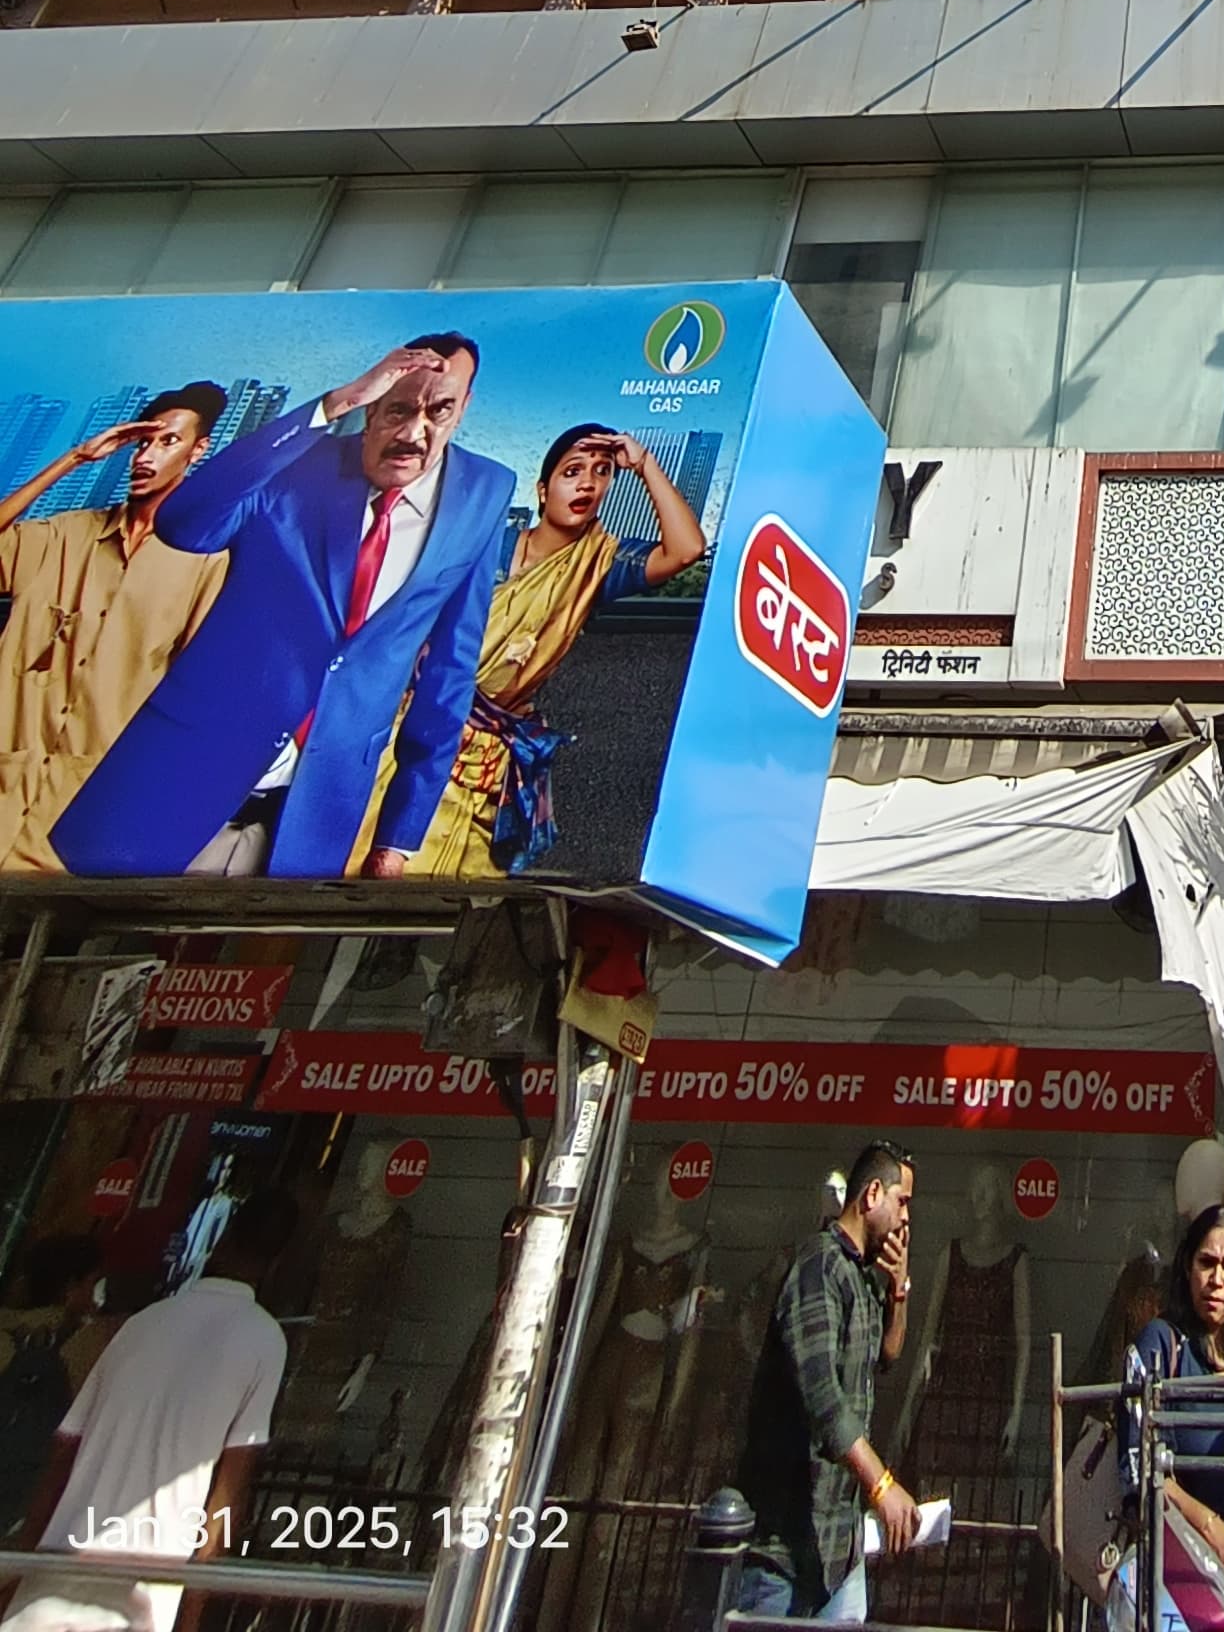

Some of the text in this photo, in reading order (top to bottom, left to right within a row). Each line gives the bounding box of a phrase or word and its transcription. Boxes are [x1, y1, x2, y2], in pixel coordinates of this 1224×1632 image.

[620, 379, 721, 396] MAHANAGAR
[648, 397, 683, 413] GAS
[755, 544, 840, 683] बेस्ट
[882, 649, 933, 678] ट्रिनिटी
[140, 996, 257, 1023] ASHIONS
[301, 1061, 361, 1091] SALE
[367, 1062, 435, 1093] UPTO
[662, 1071, 728, 1100] UPTO
[734, 1062, 809, 1103] 50%
[817, 1074, 865, 1103] OFF
[893, 1069, 1175, 1113] SALE UPTO 50% OFF
[388, 1159, 427, 1177] SALE
[671, 1160, 710, 1180] SALE
[1017, 1178, 1057, 1197] SALE
